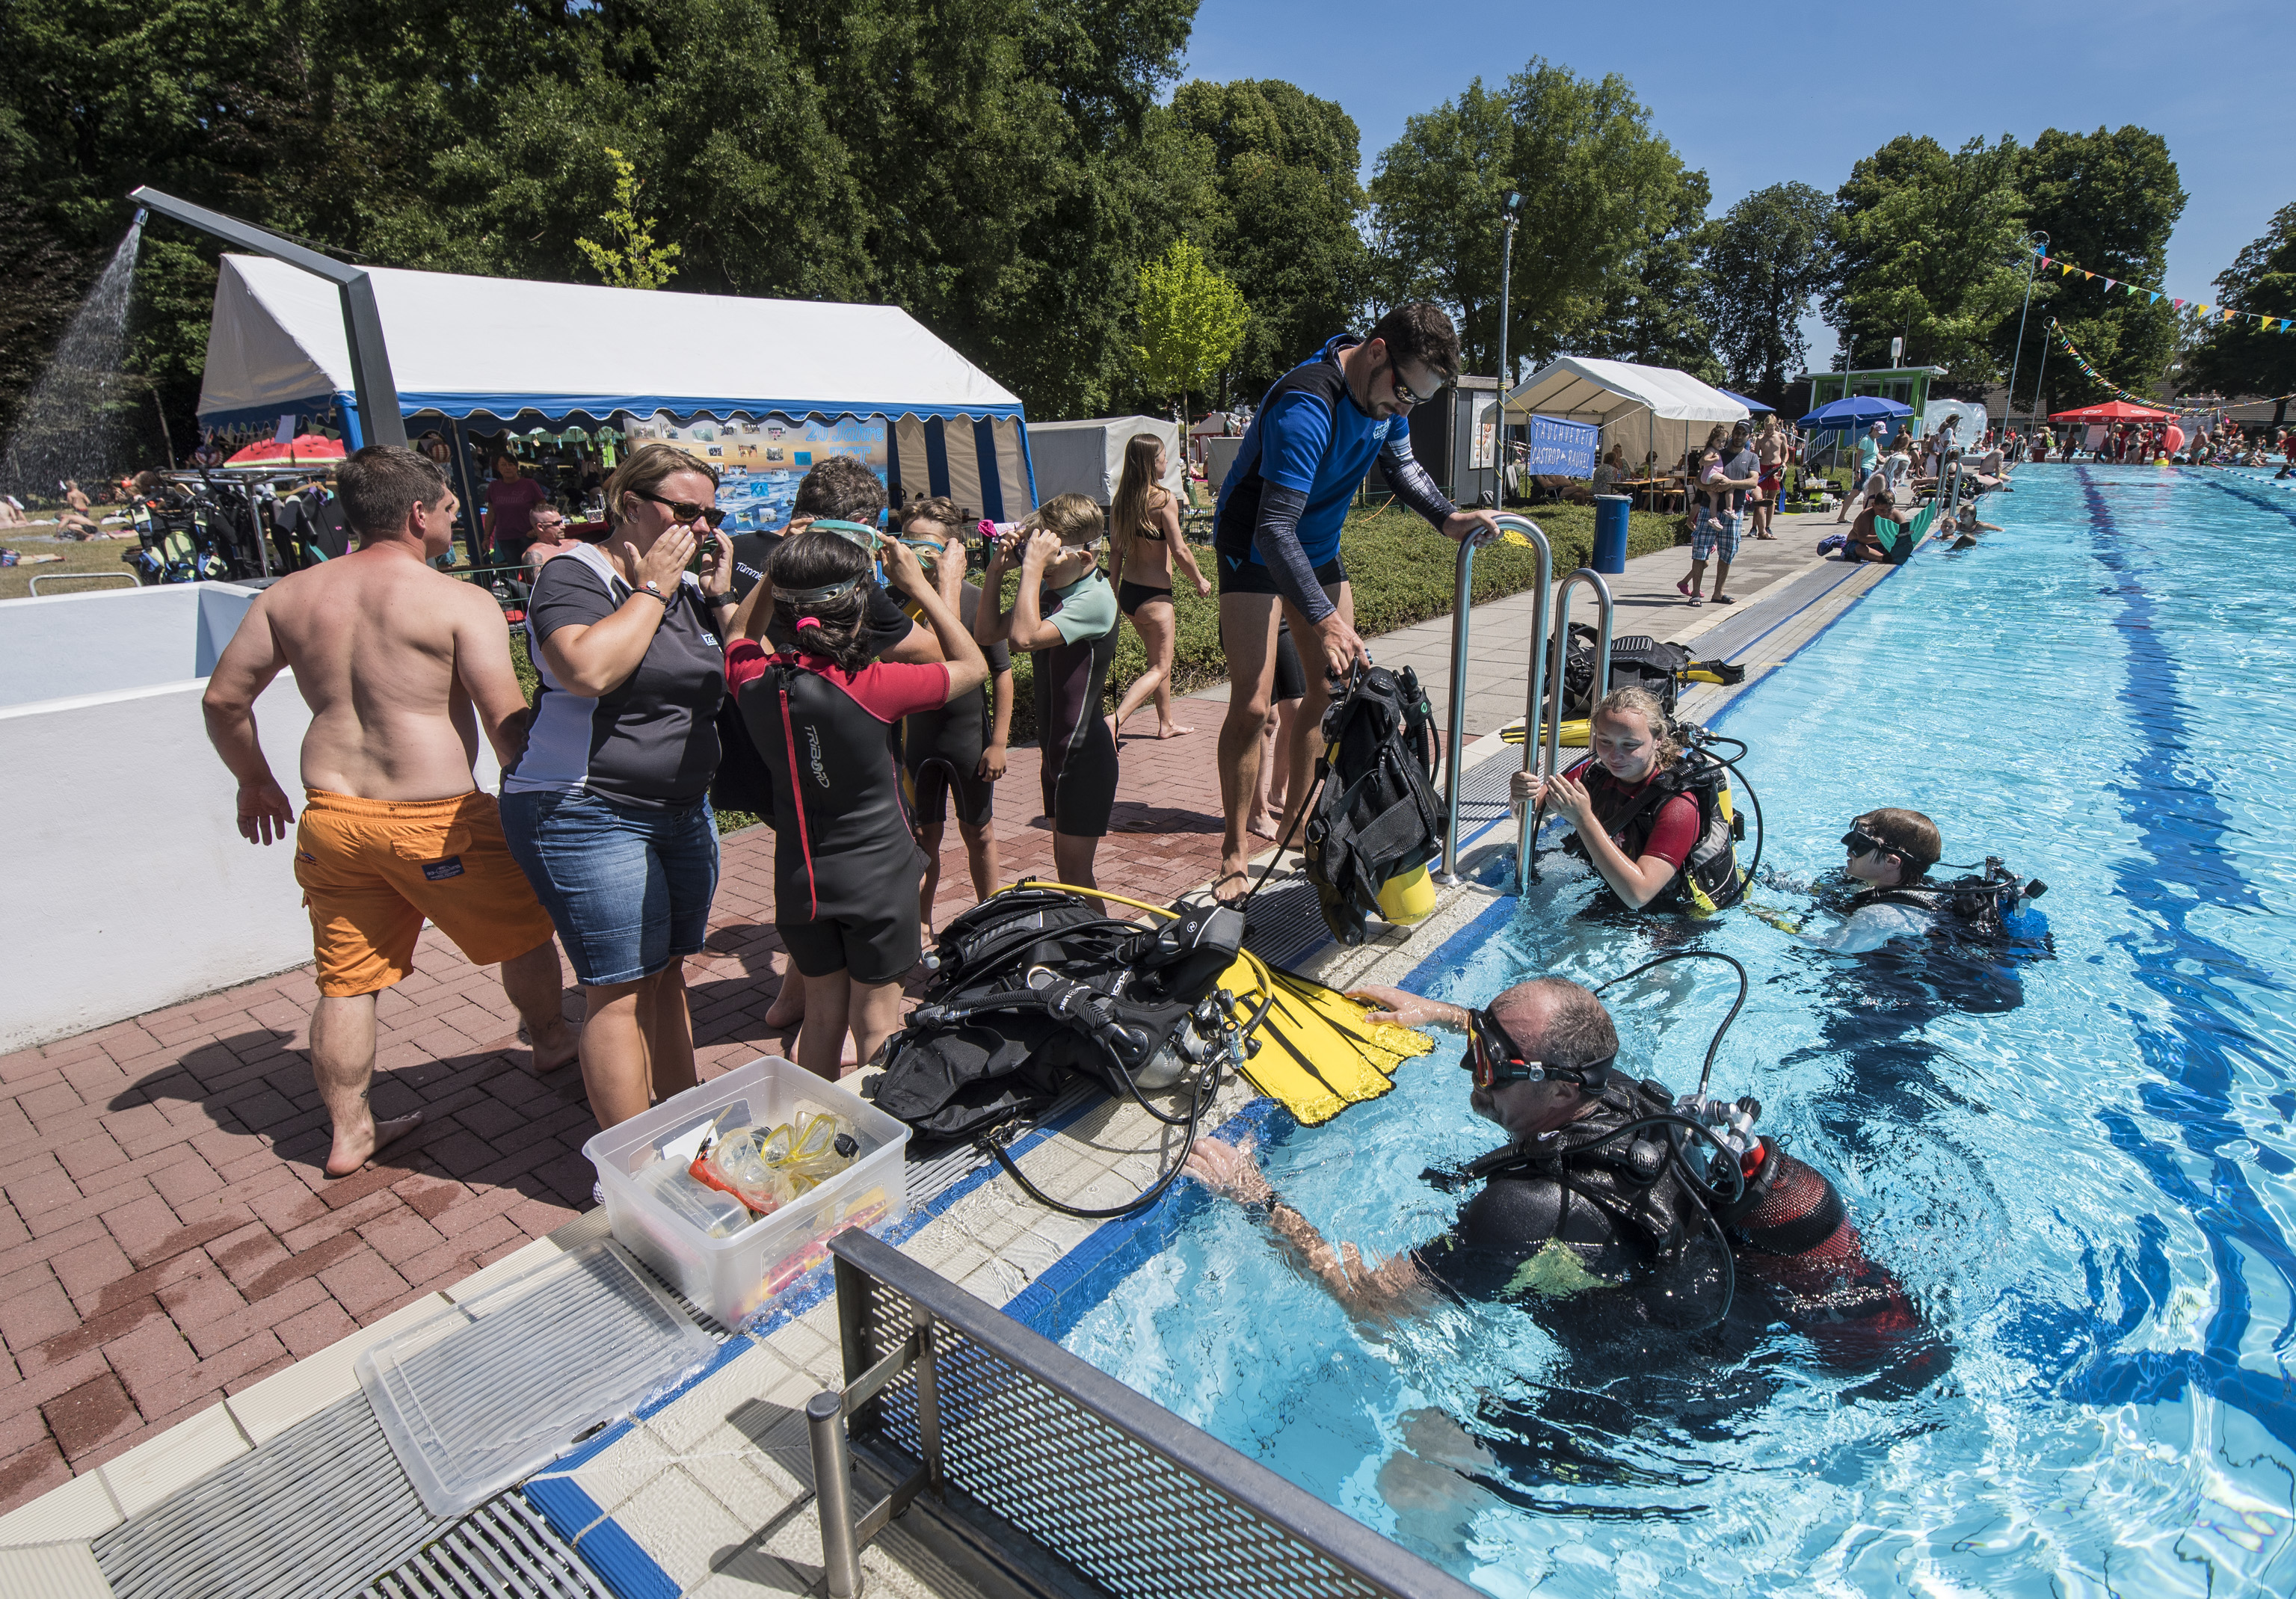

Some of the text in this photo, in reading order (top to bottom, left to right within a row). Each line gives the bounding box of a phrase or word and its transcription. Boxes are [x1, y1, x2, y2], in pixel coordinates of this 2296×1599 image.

[805, 421, 884, 442] 20 Jahre
[1535, 422, 1594, 447] TAUCHVEREIN
[1532, 446, 1589, 469] CASTROP RAUXEL
